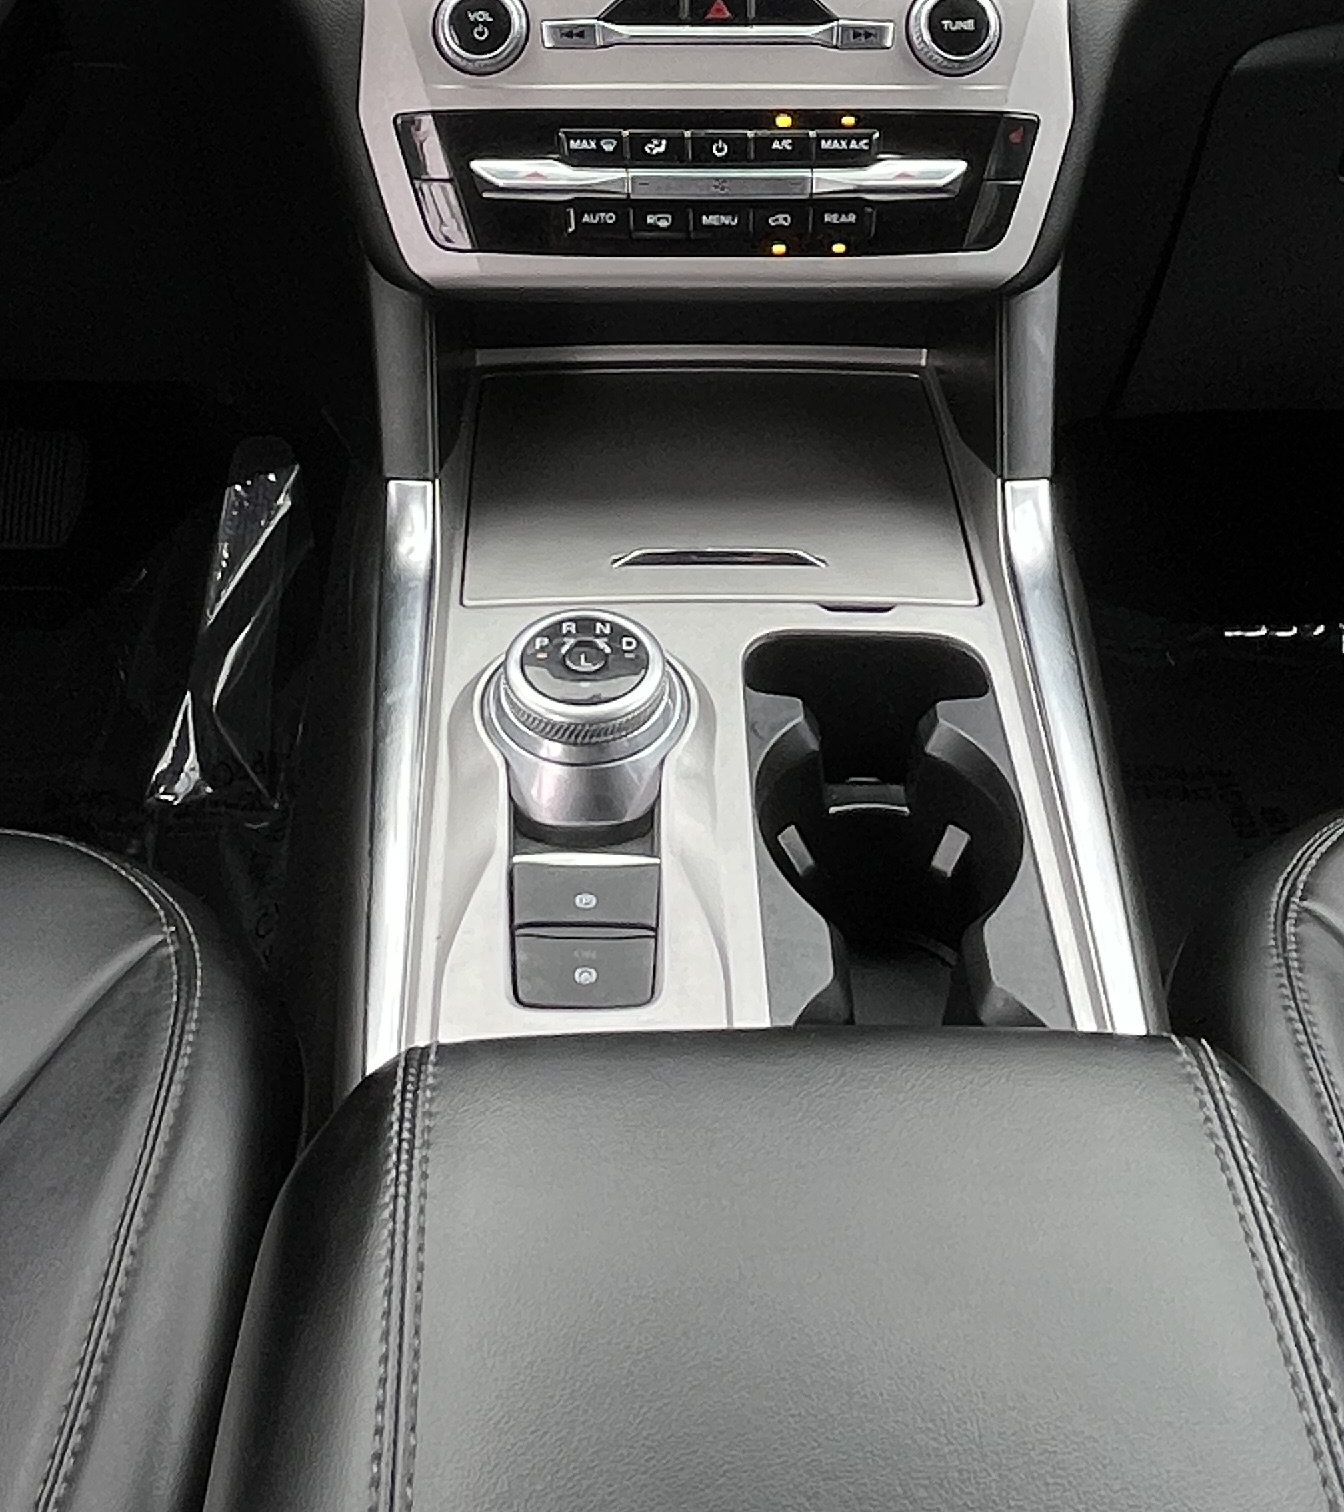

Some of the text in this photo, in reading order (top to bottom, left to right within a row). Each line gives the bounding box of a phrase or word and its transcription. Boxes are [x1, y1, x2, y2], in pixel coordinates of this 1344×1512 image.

[466, 10, 494, 22] VOL
[940, 19, 976, 31] TUNE
[569, 139, 597, 150] MAX
[771, 139, 793, 150] A/C
[820, 139, 870, 150] MAX A/C
[581, 212, 616, 224] AUTO
[701, 214, 738, 226] MENU
[823, 212, 856, 224] REAR
[562, 621, 576, 634] R
[595, 621, 611, 634] N
[535, 636, 549, 650] P
[622, 636, 637, 650] D
[580, 652, 592, 666] L
